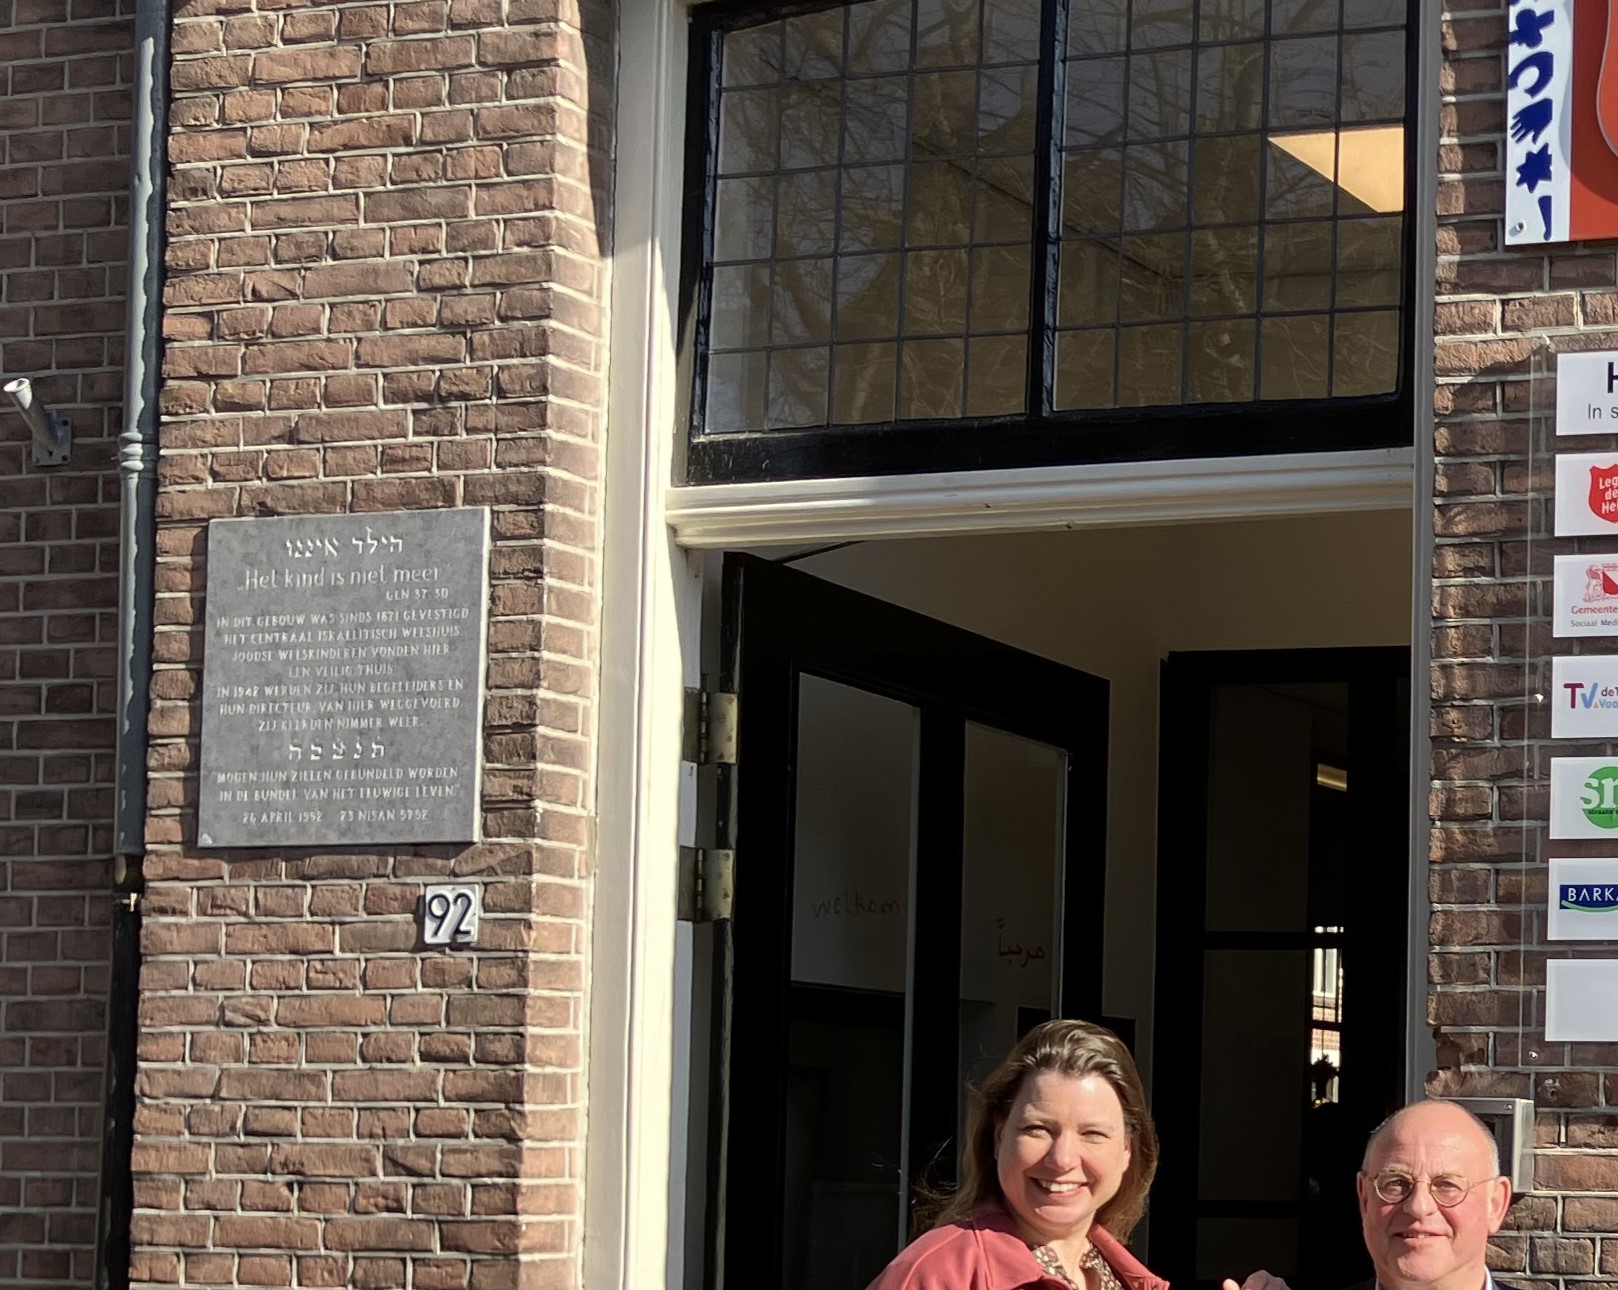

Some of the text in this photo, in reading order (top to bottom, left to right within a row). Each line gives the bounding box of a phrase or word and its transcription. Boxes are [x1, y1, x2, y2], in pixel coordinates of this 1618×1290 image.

[1588, 403, 1602, 420] In
[352, 526, 403, 554] הילד
[285, 566, 326, 588] kind
[331, 571, 345, 586] is
[350, 563, 387, 585] niet
[216, 615, 230, 628] IN
[234, 615, 253, 627] DIT
[257, 614, 305, 627] GEBOUW
[310, 612, 335, 625] WAS
[340, 611, 372, 623] SINDS
[403, 607, 470, 620] GEVESTIGD
[1571, 605, 1618, 615] Gemeente
[1570, 619, 1598, 628] Sociaal
[224, 633, 247, 645] HET
[251, 631, 313, 644] CENTRAAL
[232, 642, 450, 662] JOODSE WEESKINDEREN VONDEN HIER
[216, 685, 230, 698] IN
[233, 685, 260, 698] 1942
[264, 684, 312, 696] WERDEN
[340, 681, 366, 694] HUN
[370, 679, 444, 693] BEGELEIDERS
[448, 678, 464, 691] EN
[1563, 682, 1599, 709] TV
[220, 703, 245, 716] HUN
[320, 700, 344, 713] VAN
[258, 719, 277, 732] ZIJ
[337, 717, 383, 730] NIMMER
[261, 769, 287, 782] HUN
[336, 767, 403, 781] GEBUNDELD
[408, 766, 459, 779] WORDEN
[219, 790, 232, 802] IN
[236, 790, 249, 802] DE
[254, 788, 297, 801] BUNDEL
[303, 787, 329, 800] VAN
[332, 786, 355, 800] HET
[359, 785, 410, 799] EEUWIGE
[261, 811, 293, 823] APRIL
[340, 809, 355, 821] 23
[358, 808, 396, 821] NISAN
[428, 892, 473, 937] 92
